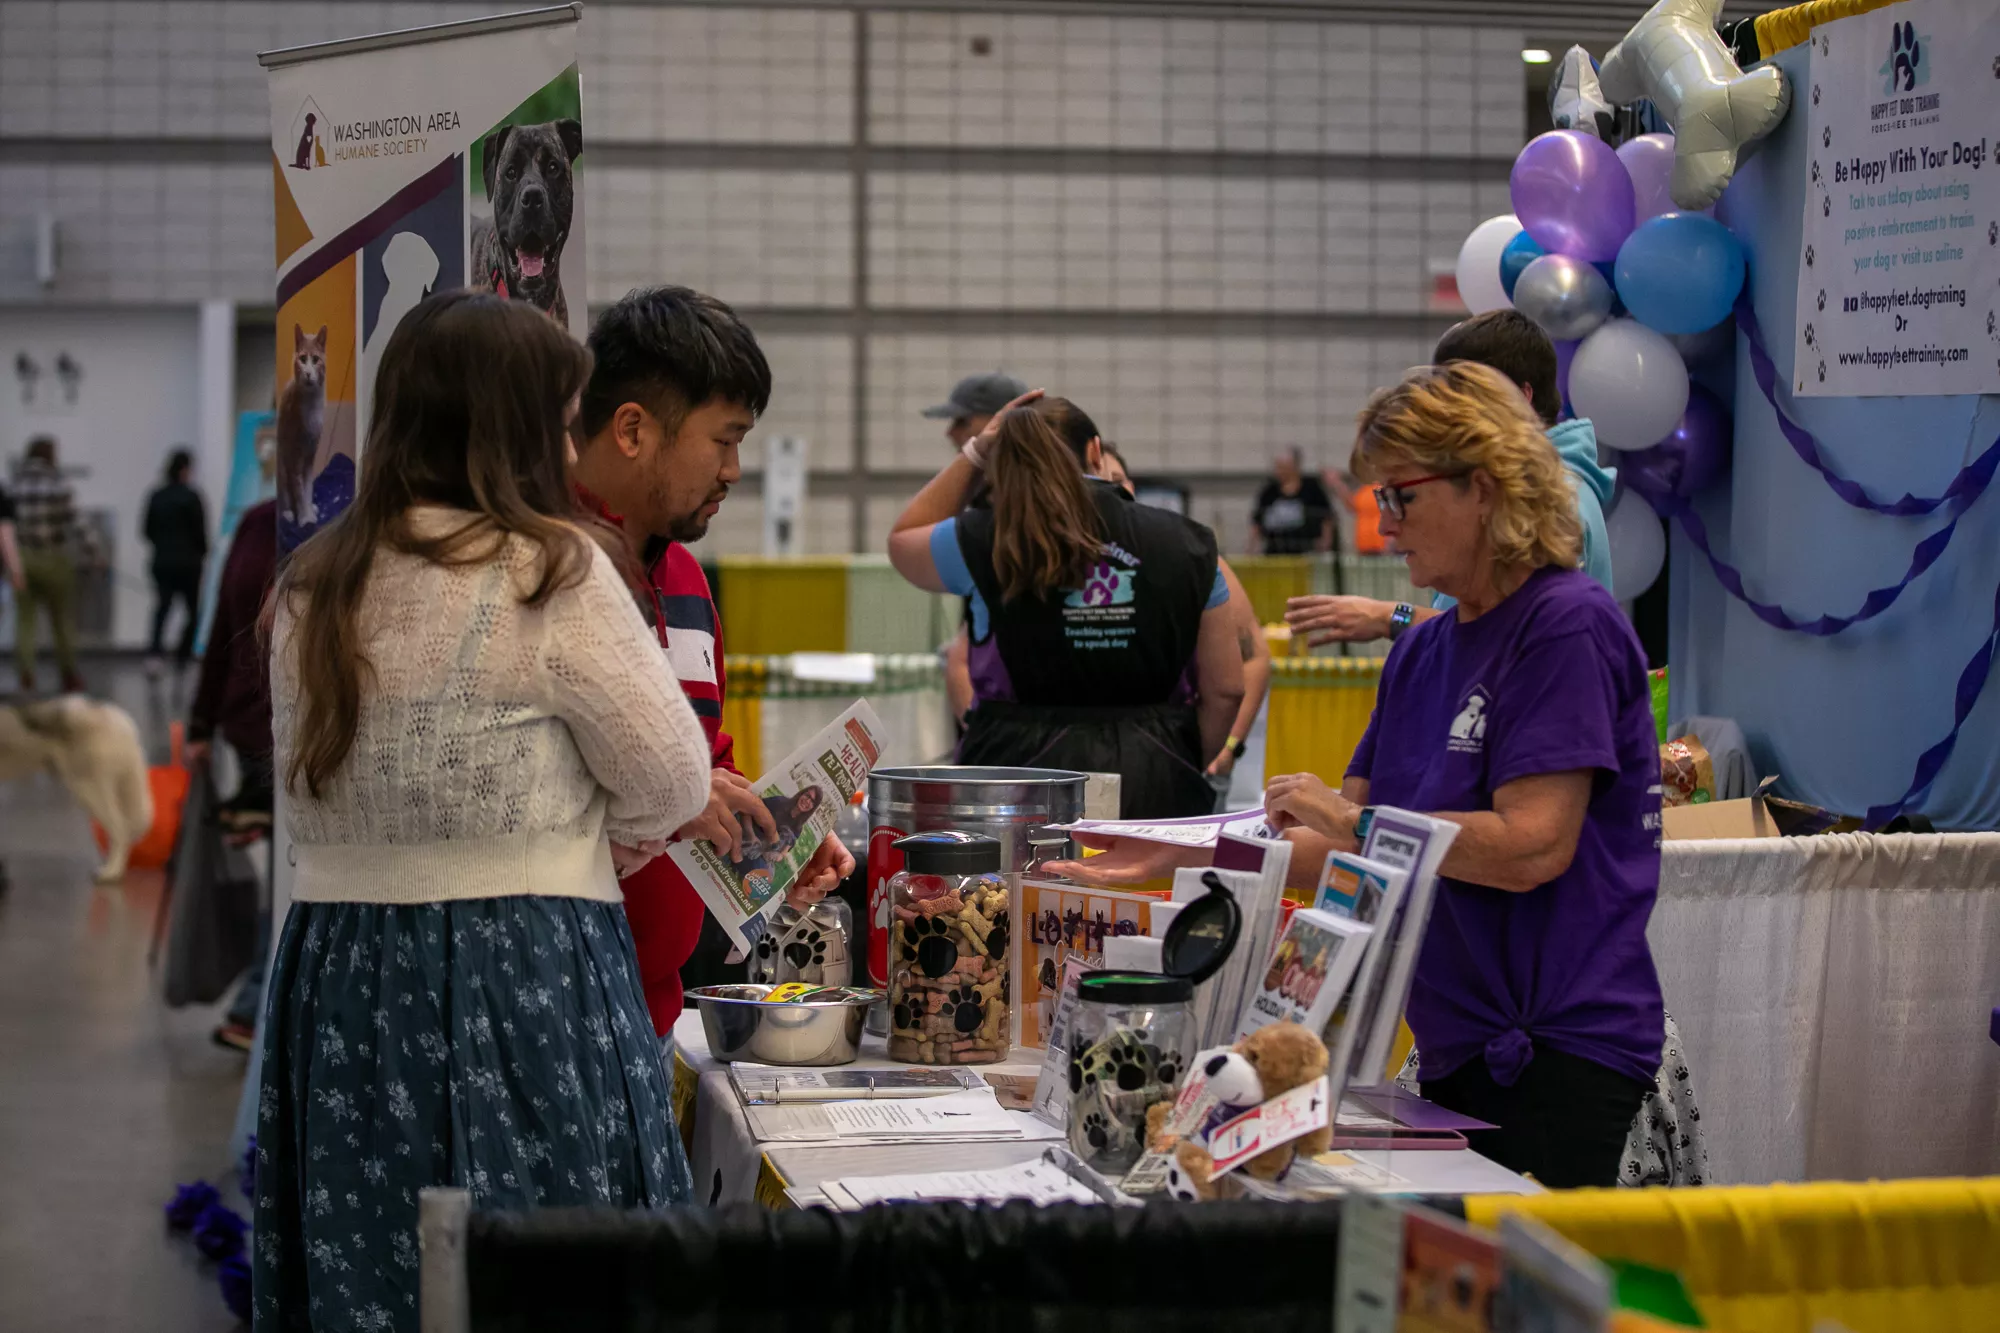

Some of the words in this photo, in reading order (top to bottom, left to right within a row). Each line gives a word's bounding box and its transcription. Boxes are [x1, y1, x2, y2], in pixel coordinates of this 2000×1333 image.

[1900, 98, 1914, 115] DOG
[1915, 93, 1940, 112] TRAINING
[334, 115, 422, 142] WASHINGTON
[426, 110, 460, 132] AREA
[1910, 114, 1940, 128] TRAINING
[335, 143, 379, 161] HUMANE
[384, 138, 428, 156] SOCIETY
[1835, 160, 1848, 184] Be
[1850, 157, 1886, 185] Happy
[1890, 149, 1918, 175] With
[1920, 146, 1948, 170] Your
[1952, 138, 1986, 170] Dog!
[1849, 192, 1866, 210] Talk
[1867, 194, 1875, 208] to
[1877, 194, 1886, 207] us
[1888, 186, 1913, 208] today
[1915, 183, 1942, 202] about
[1940, 216, 1946, 230] to
[1950, 210, 1974, 228] train
[1874, 250, 1890, 272] dog
[1902, 245, 1920, 265] visit
[1922, 251, 1933, 264] us
[1936, 242, 1964, 262] online
[1894, 314, 1908, 332] Or
[824, 754, 842, 771] PET
[744, 873, 770, 896] COOLEST
